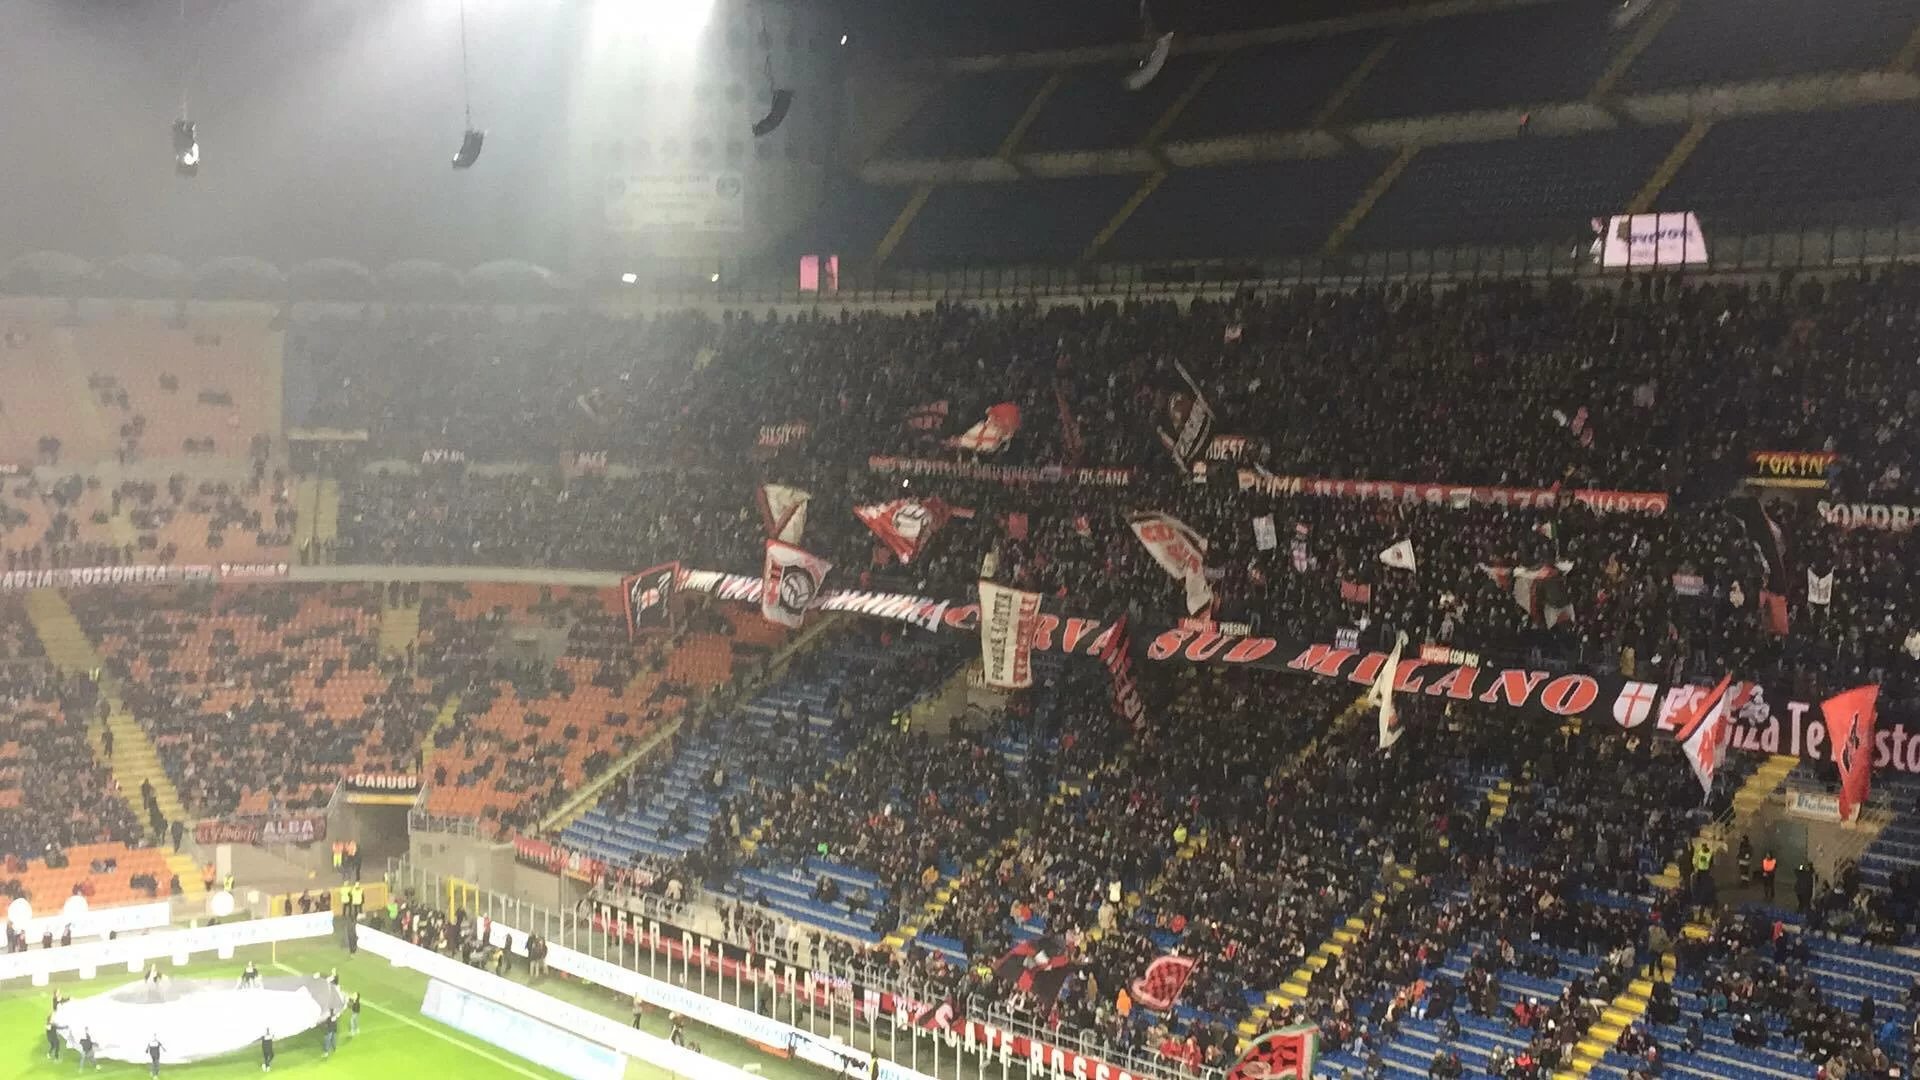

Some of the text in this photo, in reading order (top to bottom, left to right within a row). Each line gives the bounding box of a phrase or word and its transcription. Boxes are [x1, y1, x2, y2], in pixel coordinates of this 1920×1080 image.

[945, 603, 1117, 655] CRVA
[1147, 627, 1277, 662] SUD
[1287, 643, 1598, 715] MILANO
[263, 819, 314, 835] ALBA
